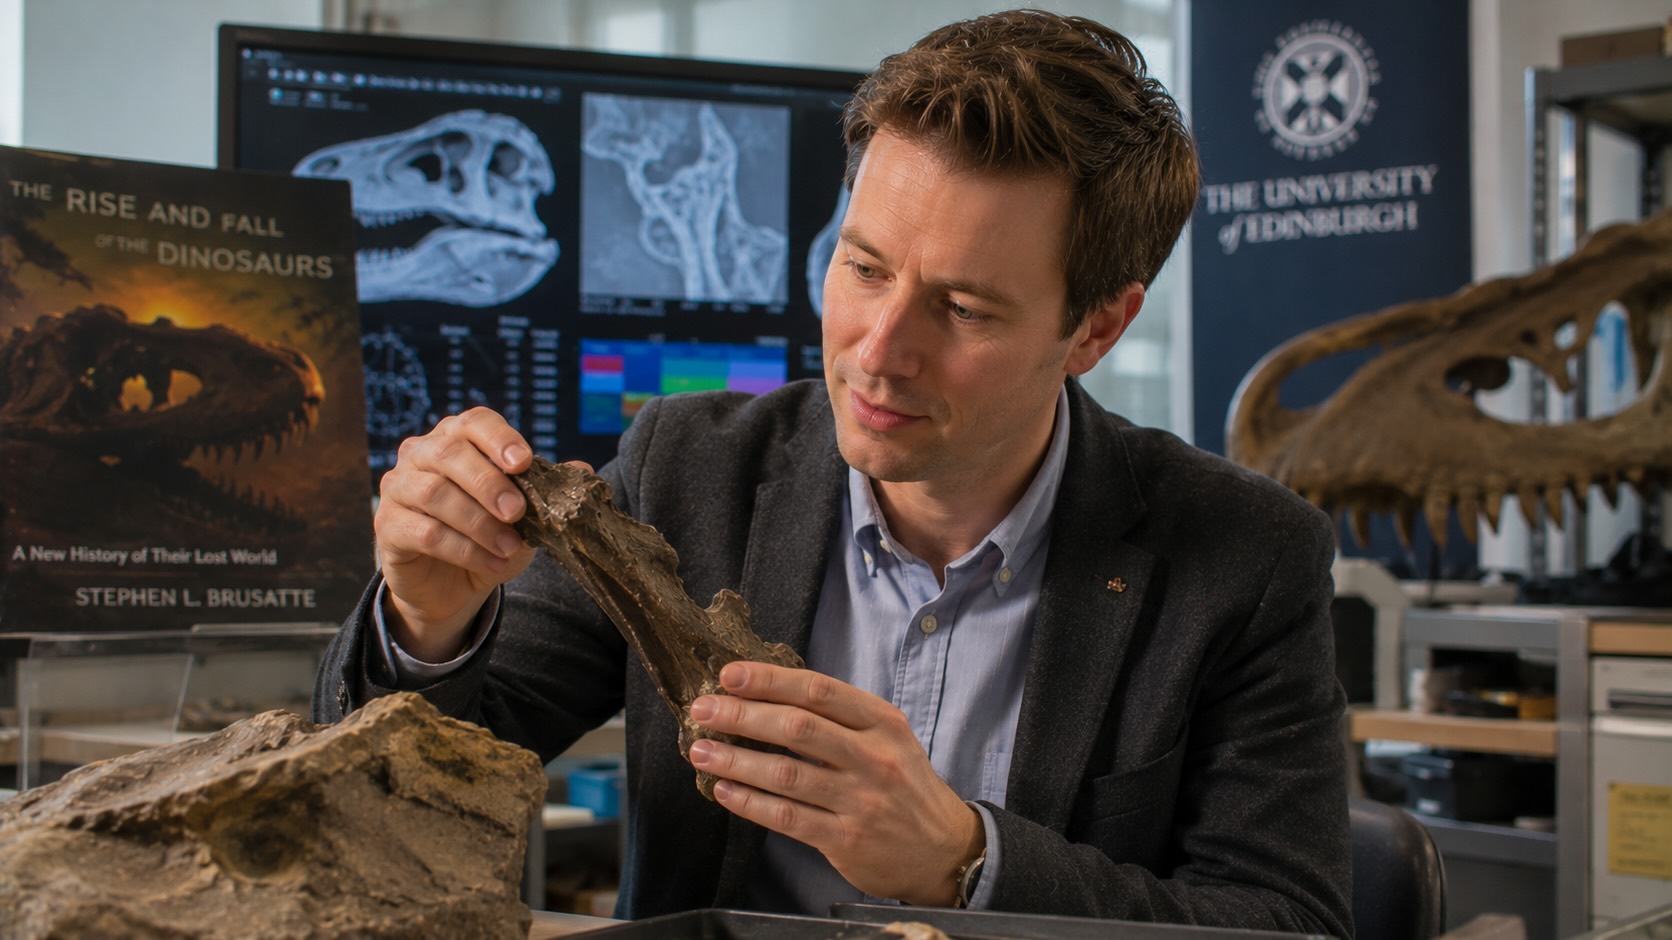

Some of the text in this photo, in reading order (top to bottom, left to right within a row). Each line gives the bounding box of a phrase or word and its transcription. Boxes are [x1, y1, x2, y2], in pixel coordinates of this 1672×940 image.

[10, 180, 284, 237] THE RISE AND FALL
[1202, 164, 1438, 214] THE UNIVERSITY
[1245, 201, 1418, 243] EDINBURGH
[117, 236, 149, 254] THE
[158, 241, 333, 279] DINOSAURS
[12, 545, 277, 567] A New History of Their Lost World
[76, 587, 316, 608] STEPHEN L. BRUSATTE
